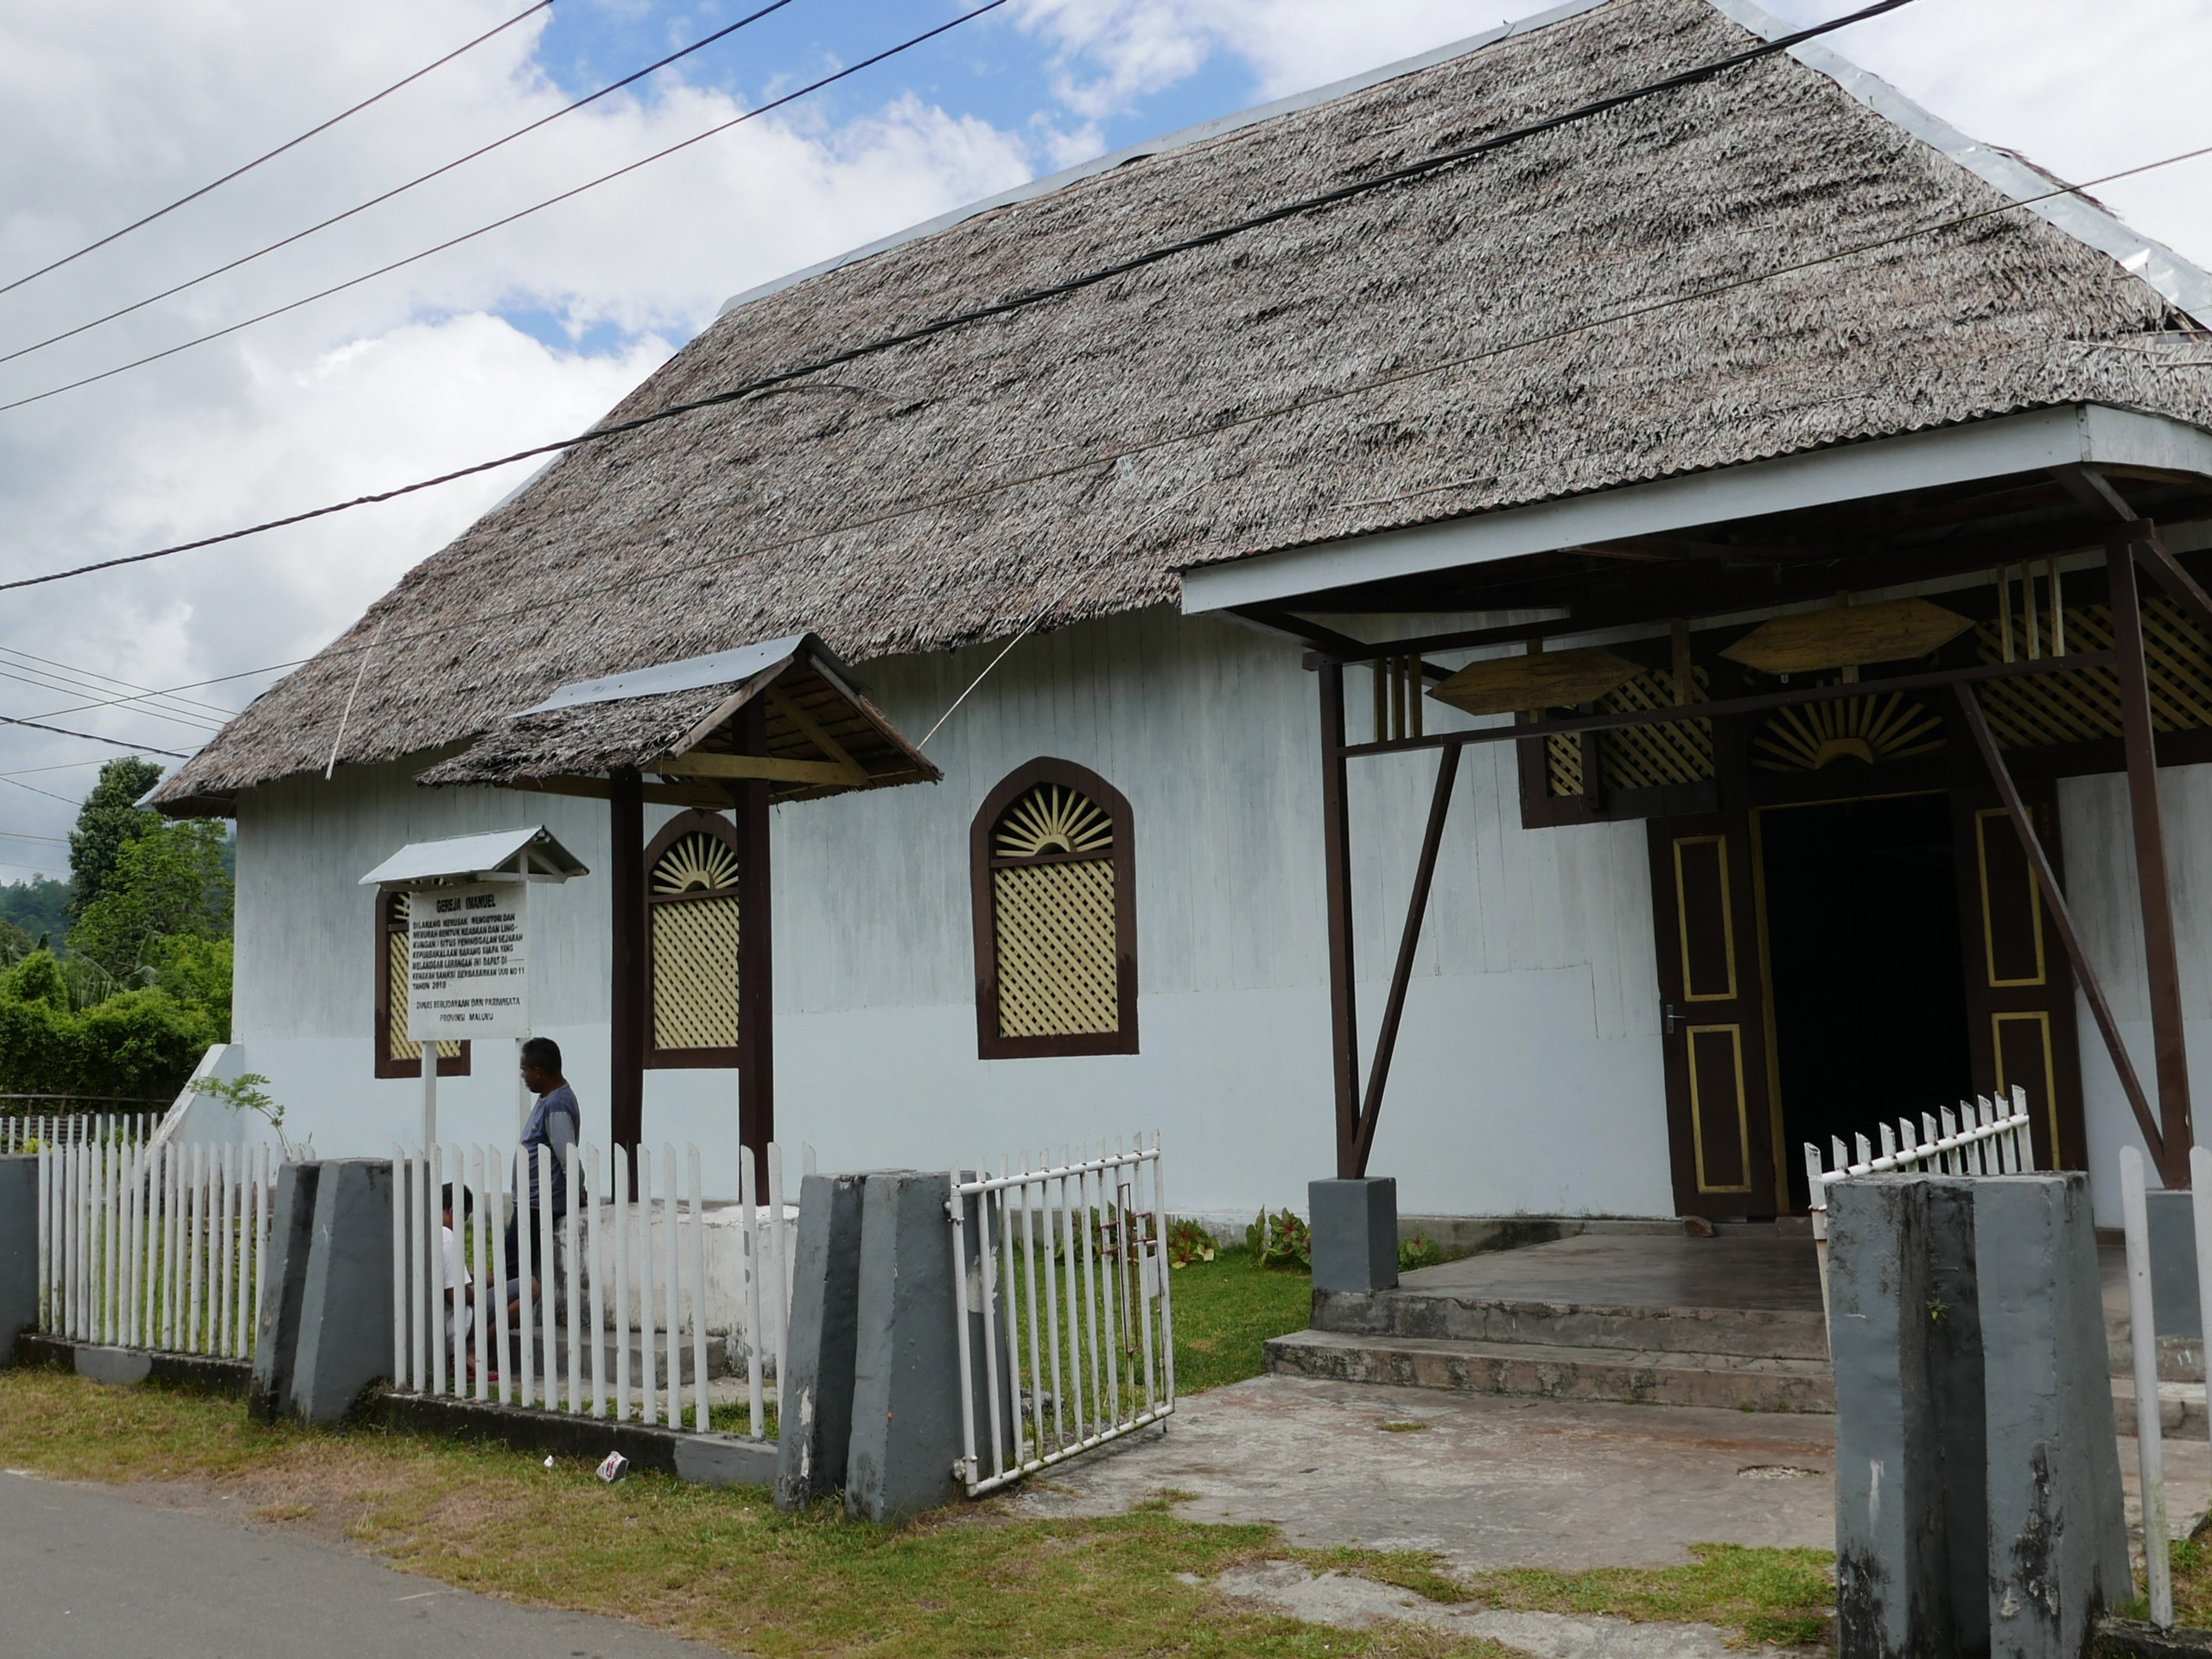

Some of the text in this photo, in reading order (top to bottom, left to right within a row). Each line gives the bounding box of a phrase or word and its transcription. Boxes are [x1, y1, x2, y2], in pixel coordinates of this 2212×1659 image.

[437, 894, 495, 913] GEREJA IMANUEL
[413, 913, 515, 929] DILARANG MERUSAK MENGOTORI DAN
[413, 929, 437, 938] MERUBAH
[439, 927, 460, 937] BENTUK
[461, 926, 487, 936] KEADAAN
[488, 925, 500, 933] DAN
[440, 939, 456, 947] SITUS
[458, 936, 497, 946] PENINGGALAN
[498, 934, 523, 943] SEJARAH
[459, 948, 481, 956] BARANG
[483, 946, 498, 955] SIAPA
[500, 944, 513, 953] YANG
[412, 960, 443, 969] MELANGGAR
[444, 958, 472, 968] LARANGAN
[483, 957, 500, 965] DAPAT
[436, 971, 455, 979] SANKSI
[457, 968, 496, 979] BERDASARKAN
[416, 1001, 432, 1009] DINAS
[434, 999, 470, 1008] KEBUDAYAAN
[485, 997, 520, 1006] PARIWISATA
